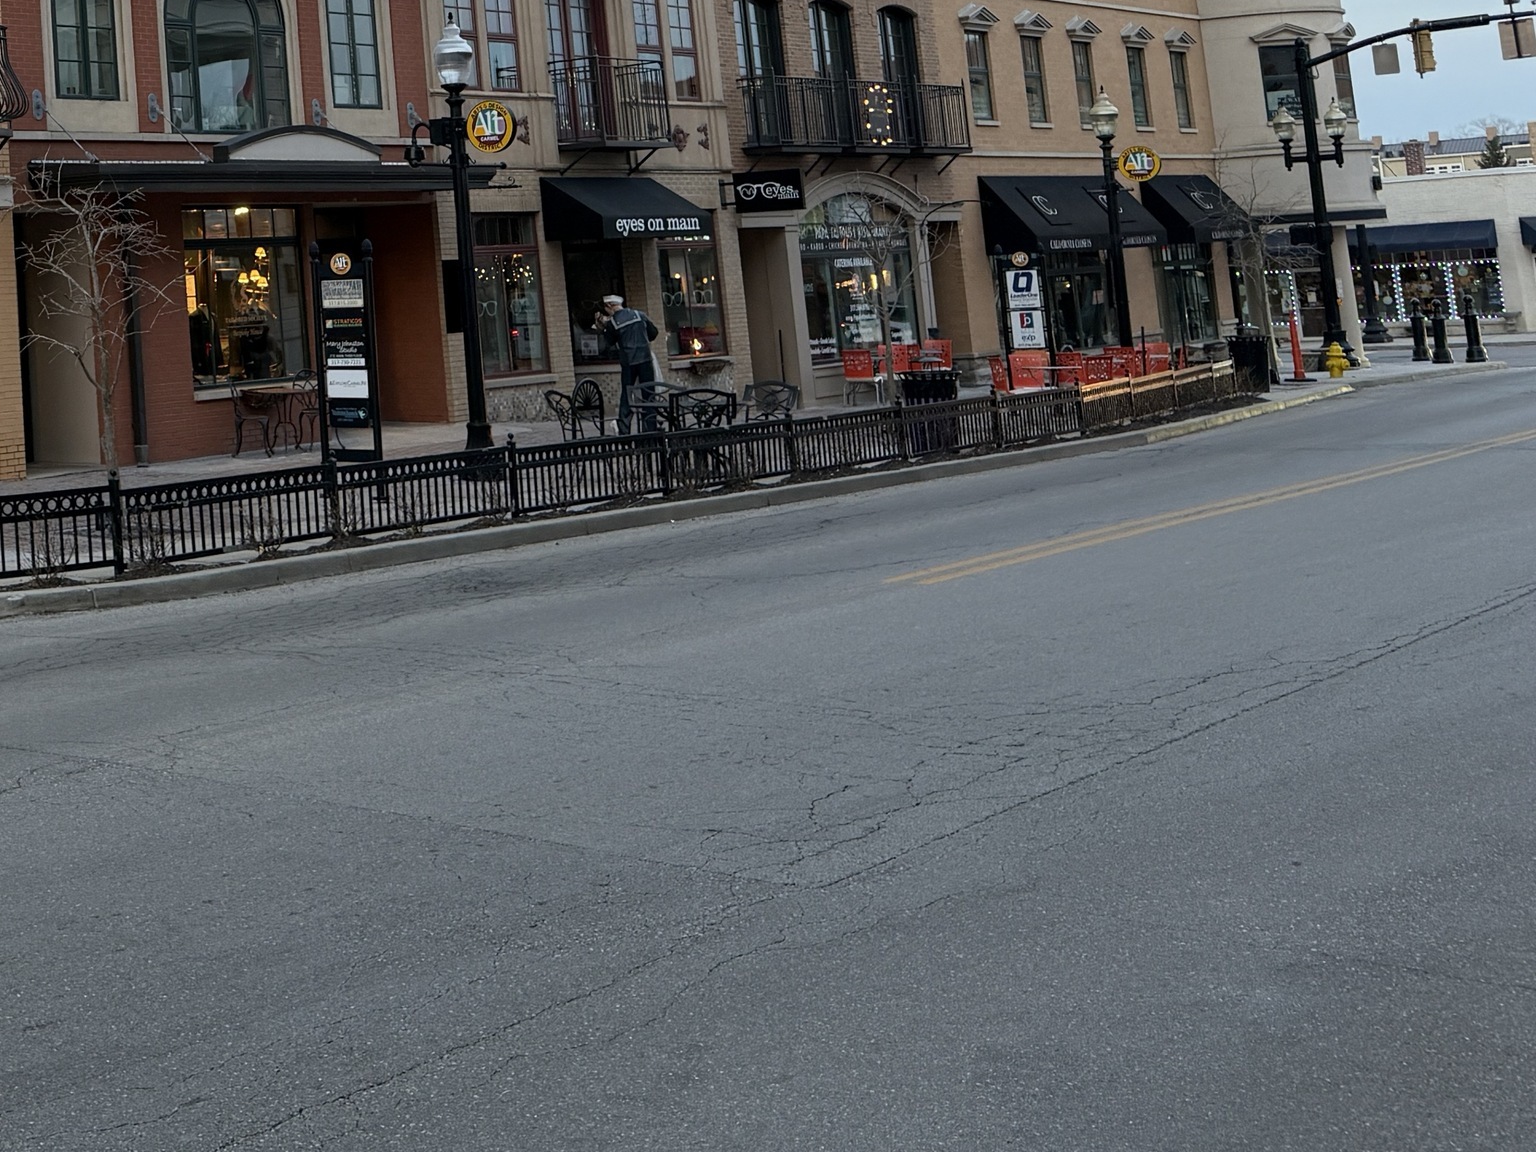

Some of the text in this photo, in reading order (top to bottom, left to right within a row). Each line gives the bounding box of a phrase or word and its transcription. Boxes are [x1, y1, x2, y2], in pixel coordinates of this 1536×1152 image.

[765, 185, 794, 198] eyes
[777, 190, 800, 200] main
[615, 217, 701, 237] eyes on main
